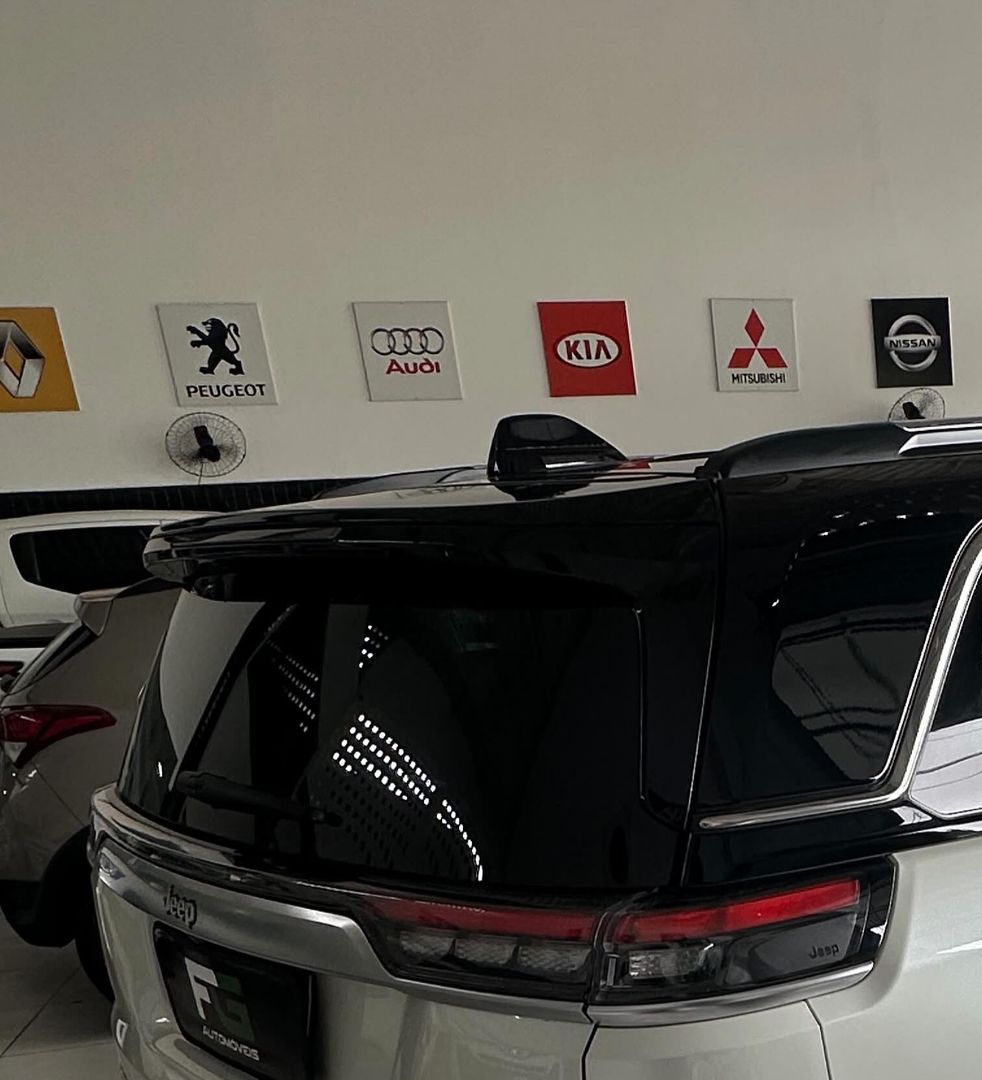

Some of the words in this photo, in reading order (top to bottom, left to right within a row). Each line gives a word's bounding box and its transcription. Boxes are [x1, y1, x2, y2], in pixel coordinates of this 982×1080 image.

[564, 340, 611, 361] KIA
[889, 339, 936, 349] NISSAN
[386, 358, 441, 375] Audi
[731, 373, 785, 384] MITSUBISHI
[186, 384, 266, 398] PEUGEOT
[165, 885, 197, 929] Jeep
[809, 944, 839, 959] Jeep
